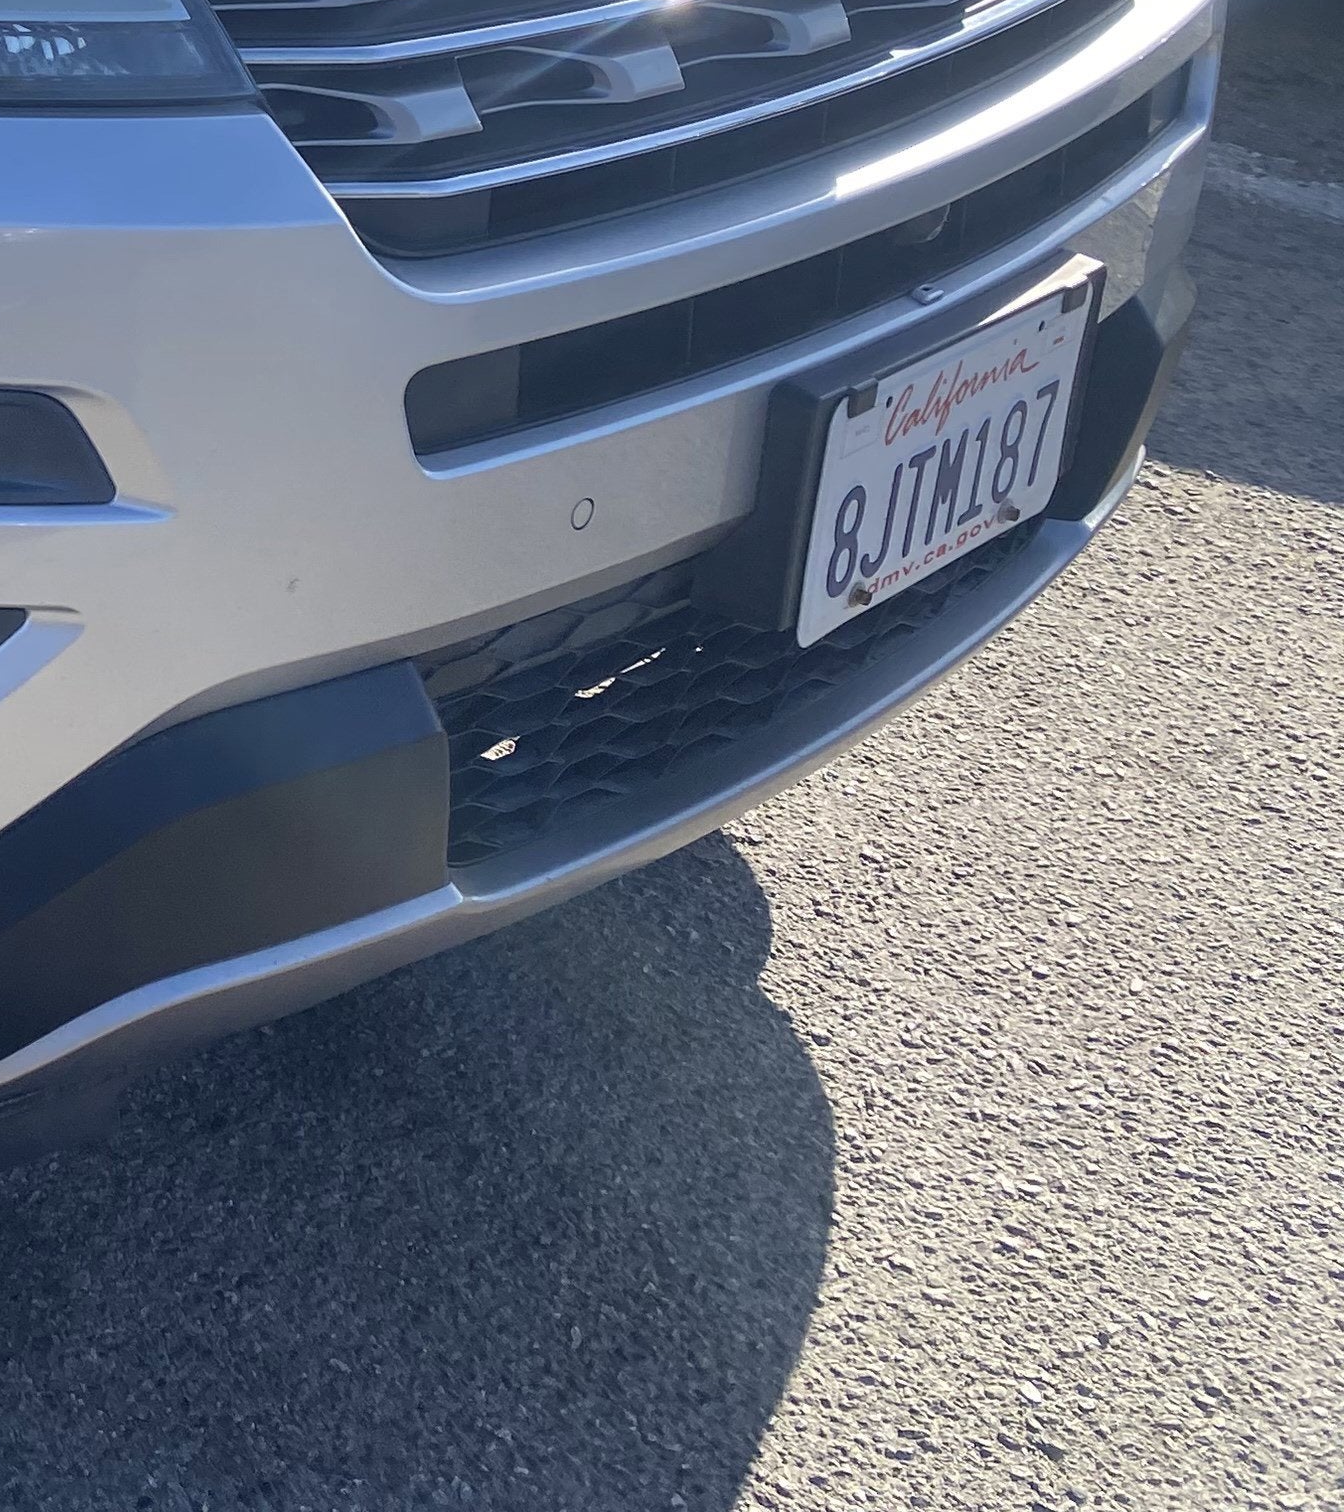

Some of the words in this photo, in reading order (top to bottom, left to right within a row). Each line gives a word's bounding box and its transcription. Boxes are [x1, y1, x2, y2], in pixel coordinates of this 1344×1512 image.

[883, 346, 1041, 446] California
[826, 379, 1061, 599] 8JTM187
[866, 514, 997, 595] dmv.ca.gov
